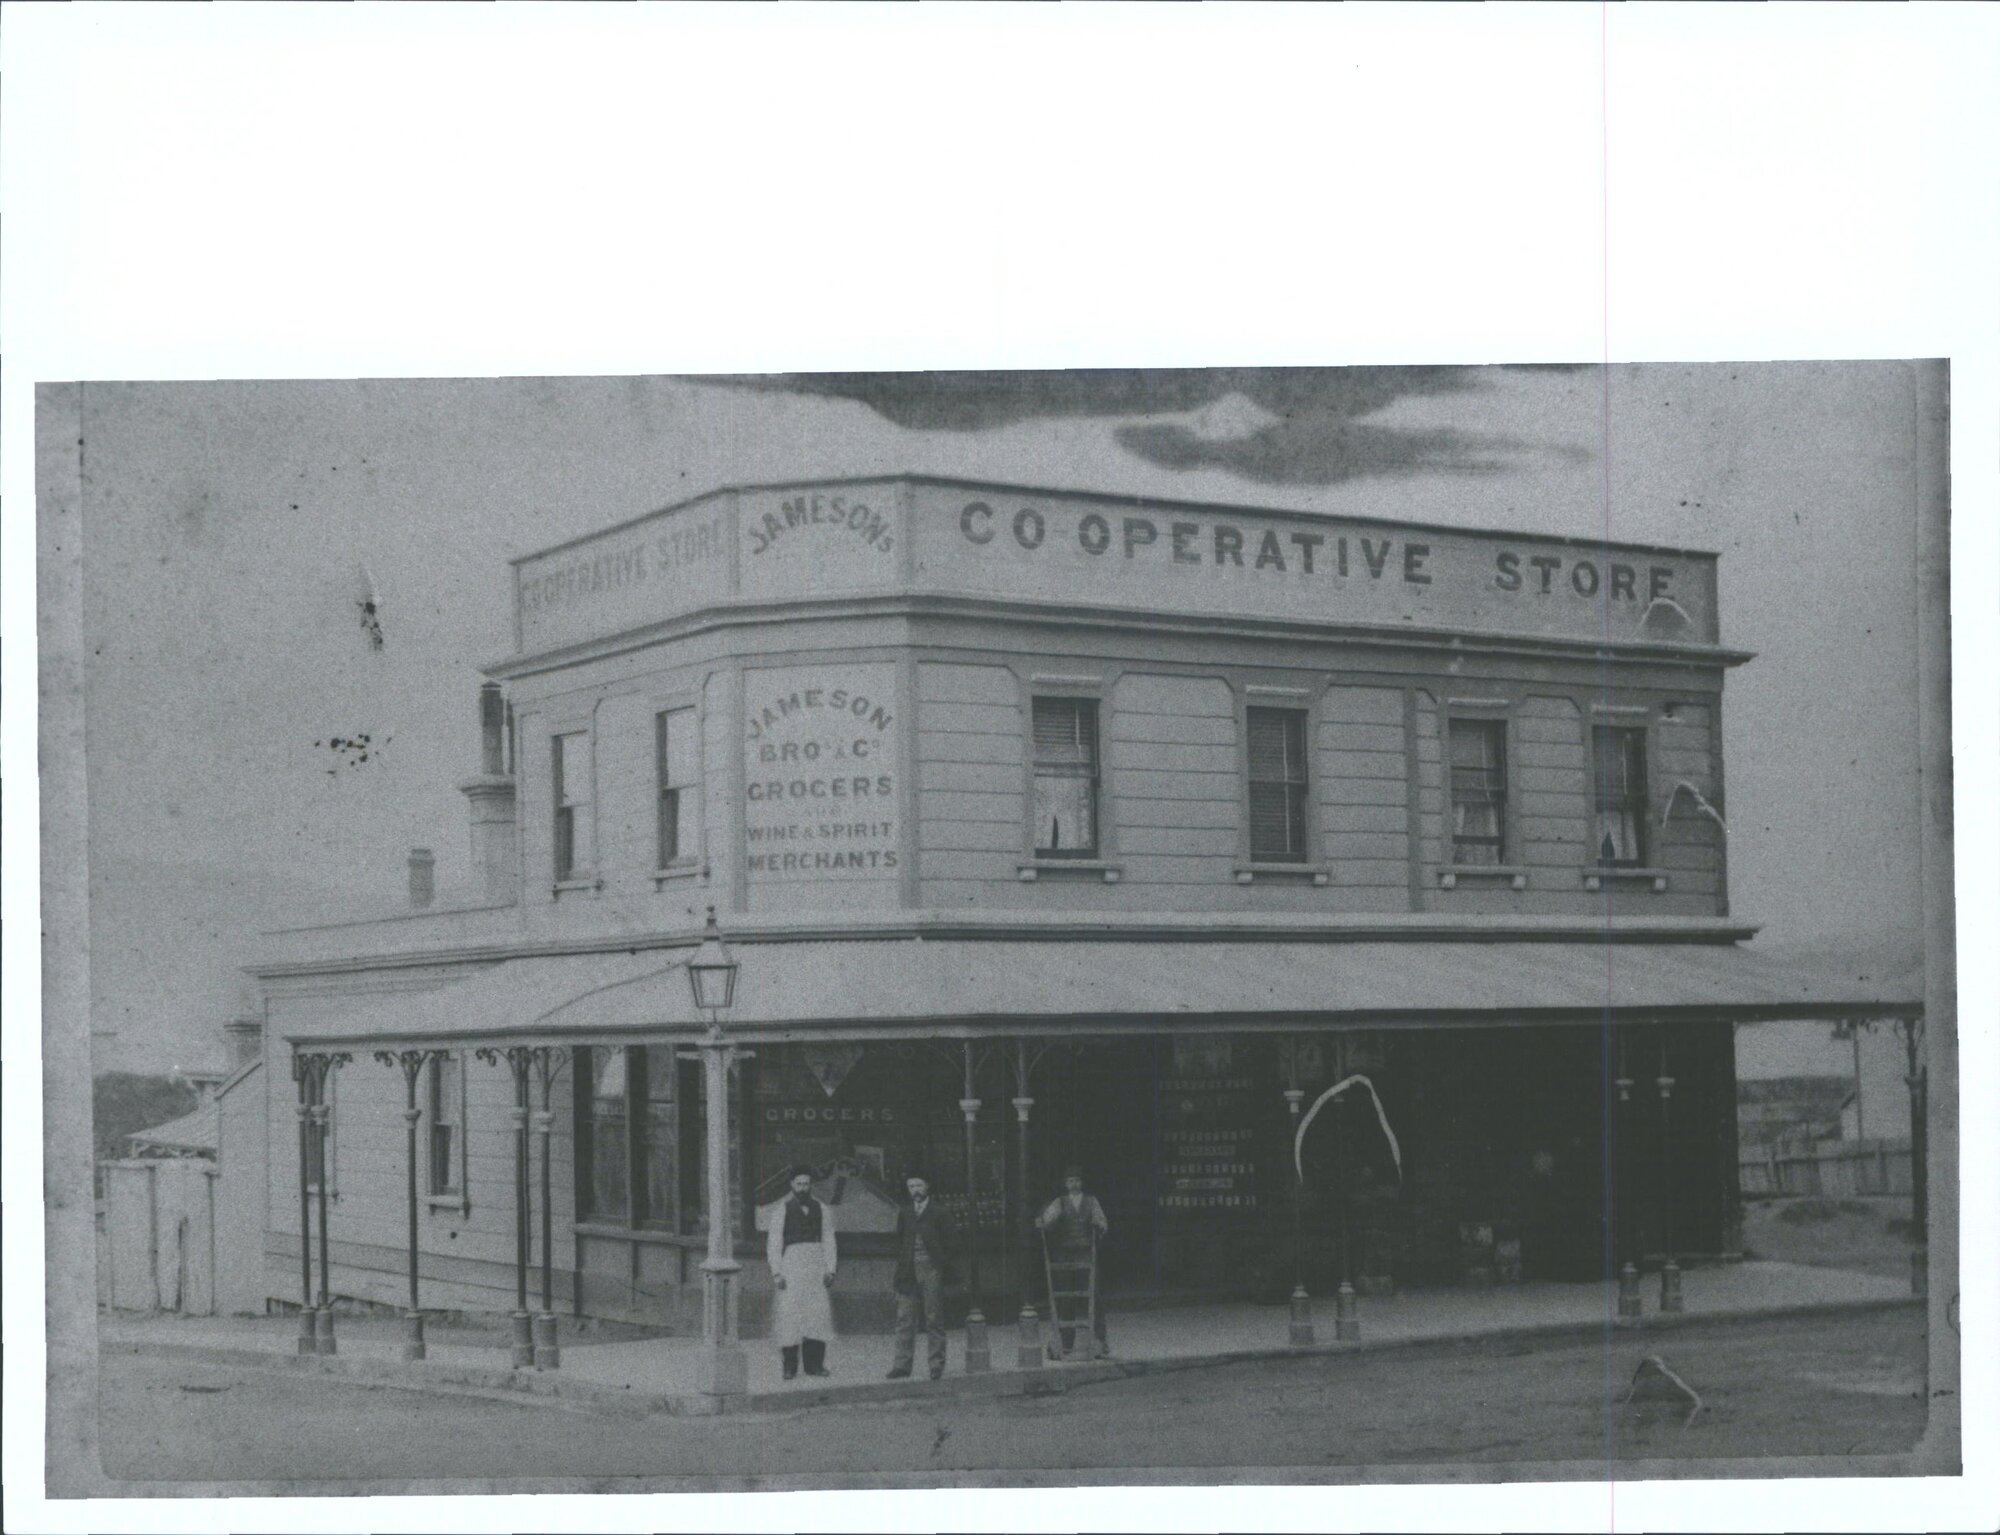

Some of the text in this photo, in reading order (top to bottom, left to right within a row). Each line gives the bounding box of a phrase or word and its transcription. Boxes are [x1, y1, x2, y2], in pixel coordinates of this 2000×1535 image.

[1494, 551, 1675, 602] STORE
[747, 688, 894, 740] JAMESON
[746, 776, 893, 802] GROCERS
[747, 821, 893, 842] WINE & SPIRIT
[746, 850, 899, 872] MERCHANTS
[764, 1106, 896, 1123] GROCERS
